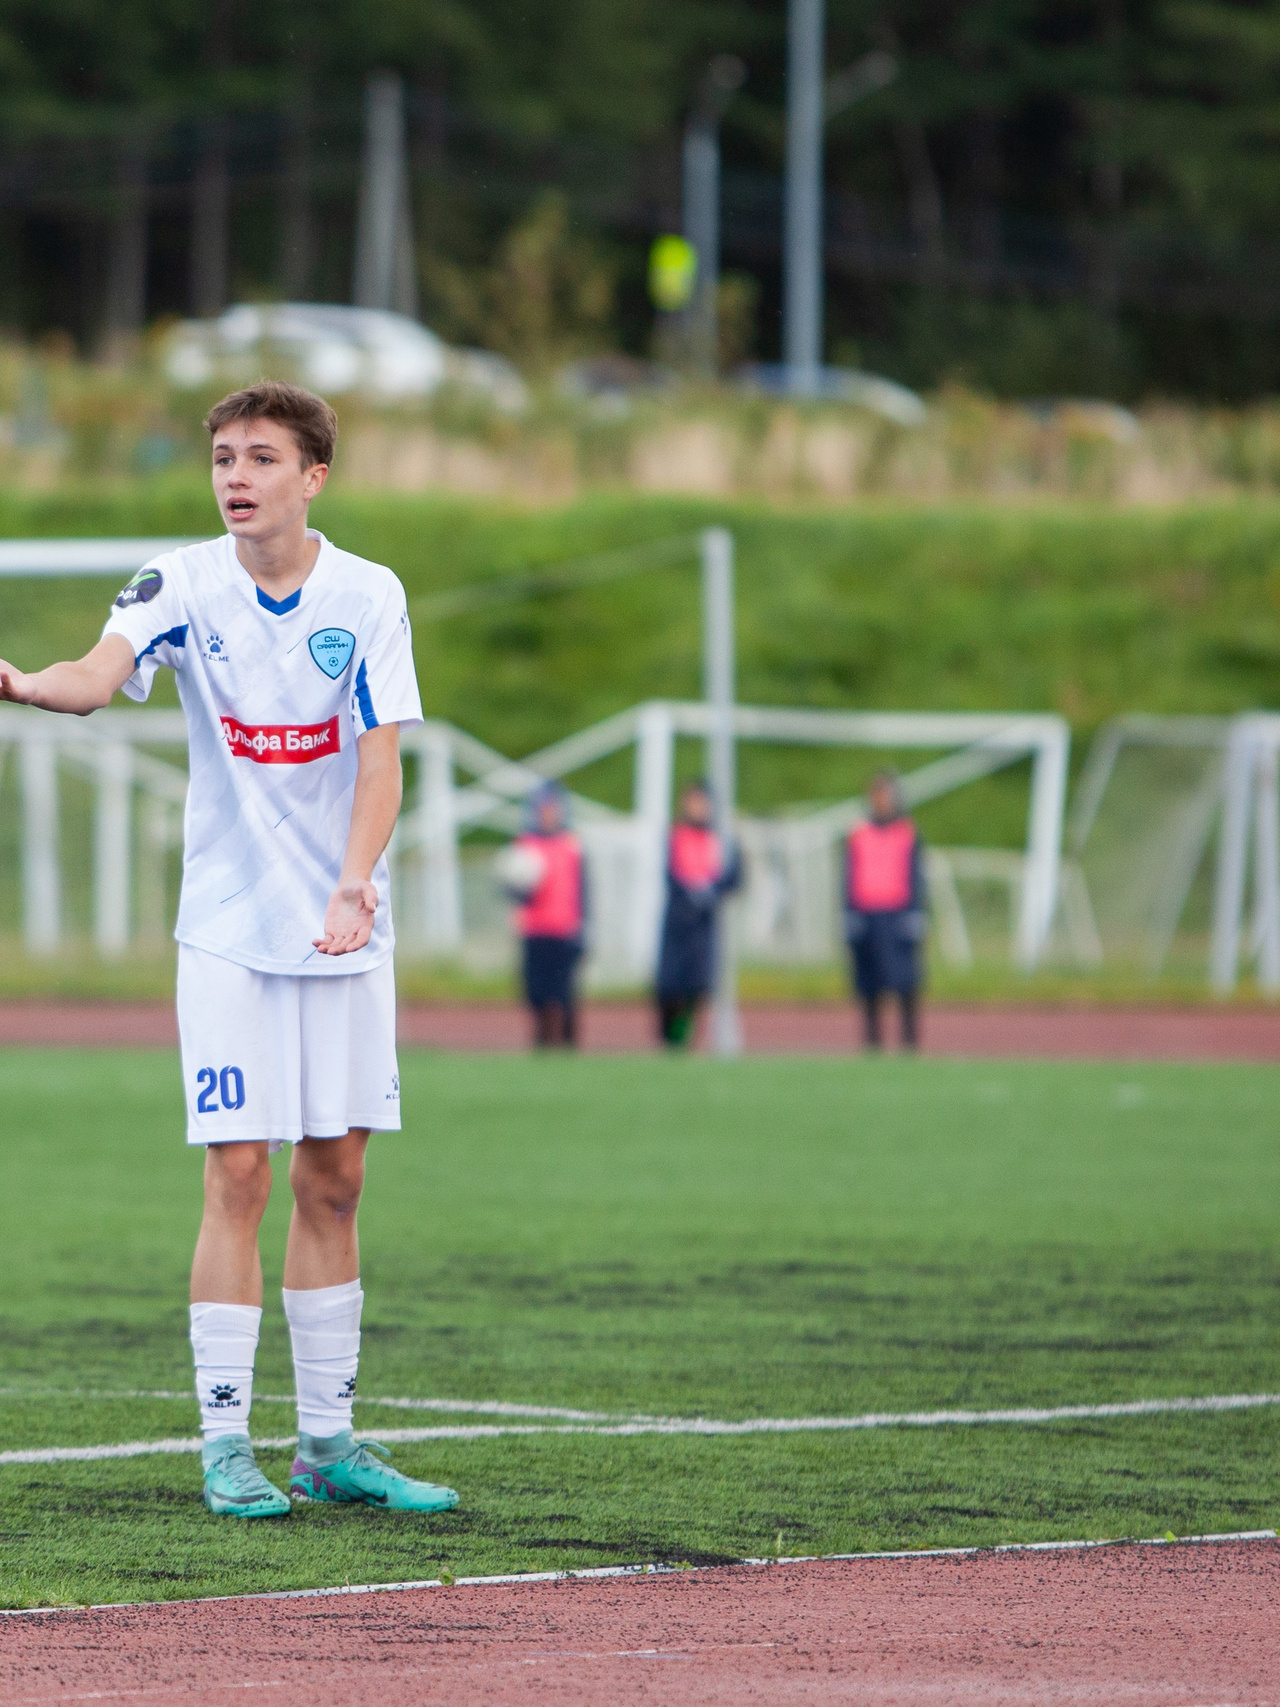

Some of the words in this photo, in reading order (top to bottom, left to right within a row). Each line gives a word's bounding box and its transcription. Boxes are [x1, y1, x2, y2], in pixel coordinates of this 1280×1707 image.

[203, 652, 230, 663] KELME
[222, 721, 282, 755] Альфа
[286, 728, 330, 750] Банк
[197, 1065, 246, 1113] 20
[207, 1399, 242, 1408] KELME
